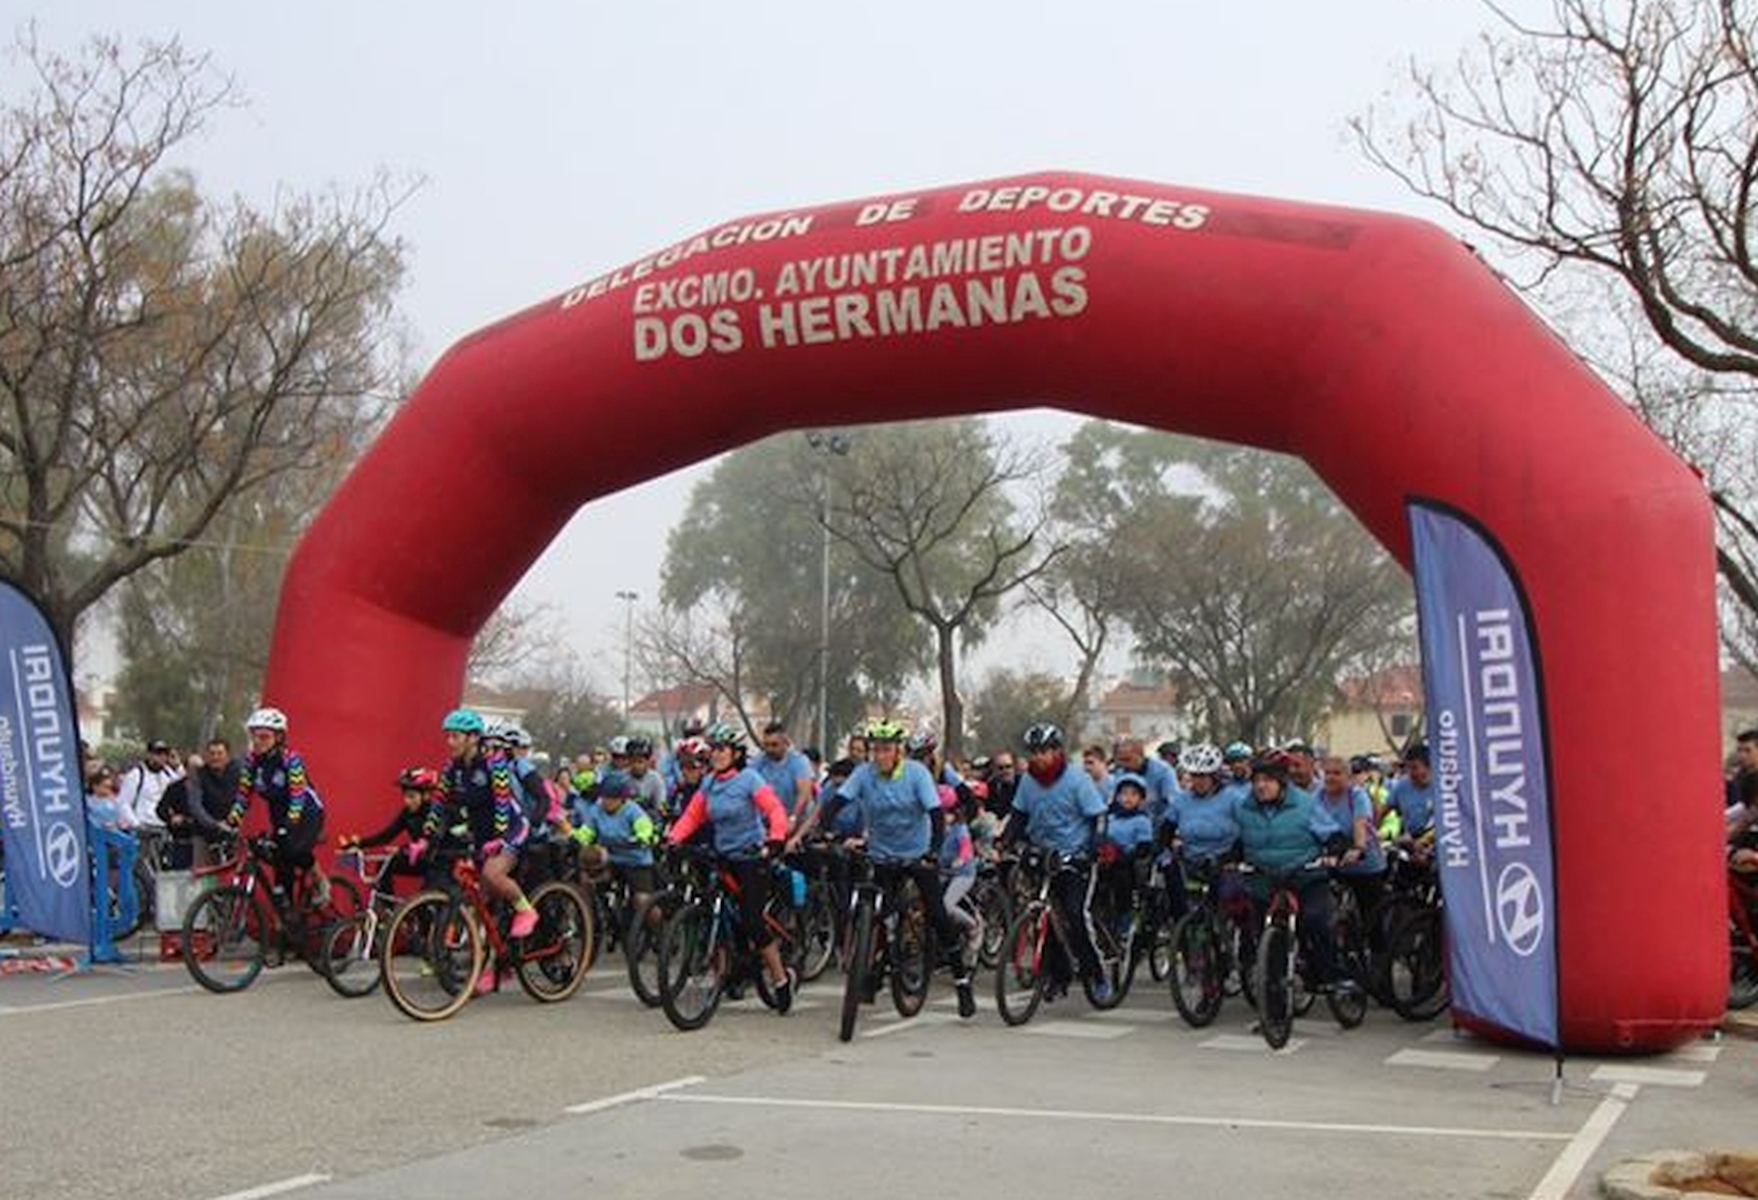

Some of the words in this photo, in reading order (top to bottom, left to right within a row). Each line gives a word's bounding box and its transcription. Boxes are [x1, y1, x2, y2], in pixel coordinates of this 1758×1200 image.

[857, 198, 917, 226] DE
[958, 186, 1210, 231] DEPORTES
[633, 268, 764, 313] EXCMO.
[775, 225, 1093, 296] AYUNTAMIENTO
[633, 310, 742, 361] DOS
[759, 265, 1090, 349] HERMANAS
